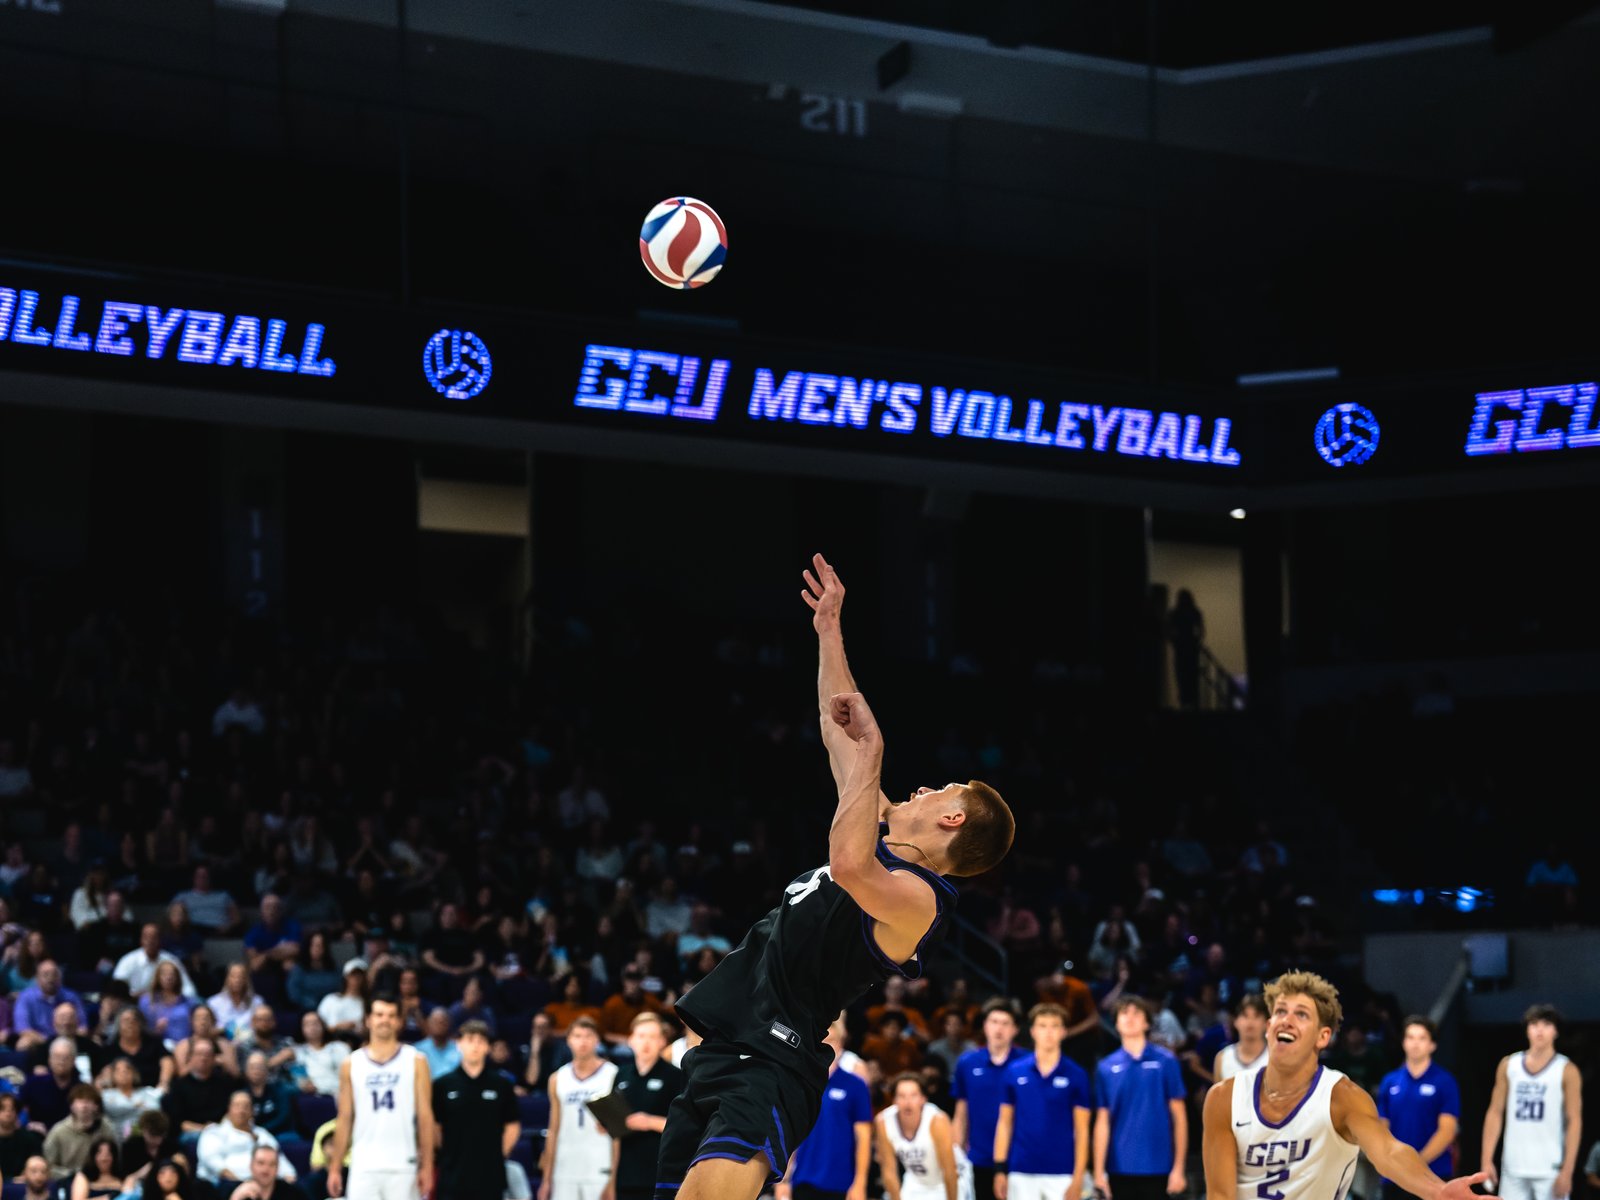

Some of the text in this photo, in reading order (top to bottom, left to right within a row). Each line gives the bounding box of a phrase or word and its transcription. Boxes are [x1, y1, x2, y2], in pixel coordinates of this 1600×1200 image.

[574, 344, 1241, 466] GCU MEN'S VOLLEYBALL
[372, 1089, 395, 1111] 14
[1515, 1099, 1545, 1121] 20
[1245, 1138, 1312, 1166] GCU
[1257, 1169, 1290, 1200] 2
